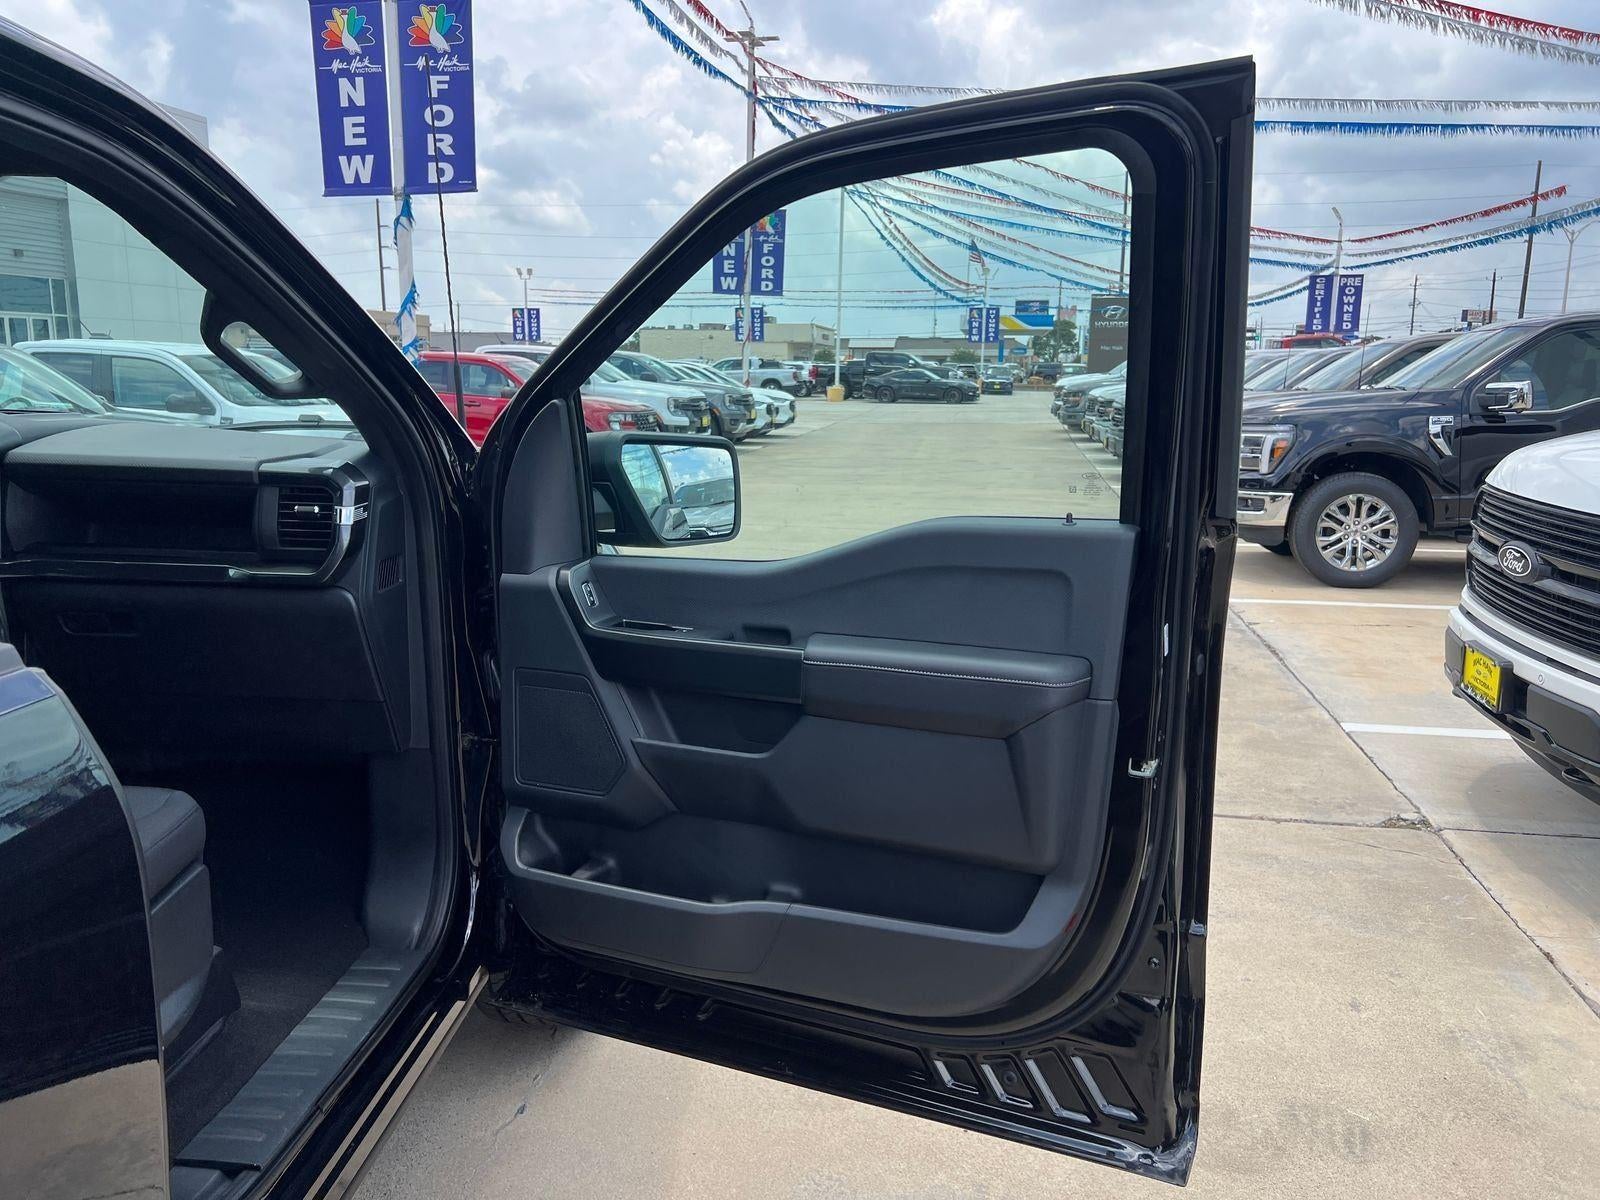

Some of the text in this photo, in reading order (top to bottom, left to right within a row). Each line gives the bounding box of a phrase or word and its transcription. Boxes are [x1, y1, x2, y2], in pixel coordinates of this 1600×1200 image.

[330, 56, 372, 74] Mac Haik
[416, 55, 437, 71] Mc
[338, 76, 374, 184] NEW
[424, 75, 455, 184] FORD
[720, 243, 737, 290] NEW
[760, 243, 775, 291] FORD
[1340, 277, 1362, 286] PRE
[1312, 277, 1326, 330] CERTIFIED
[1342, 287, 1356, 330] OWNED
[515, 321, 523, 340] NEW
[971, 321, 980, 341] NEW
[988, 309, 996, 341] HYUNDAI
[1503, 549, 1525, 572] Ford
